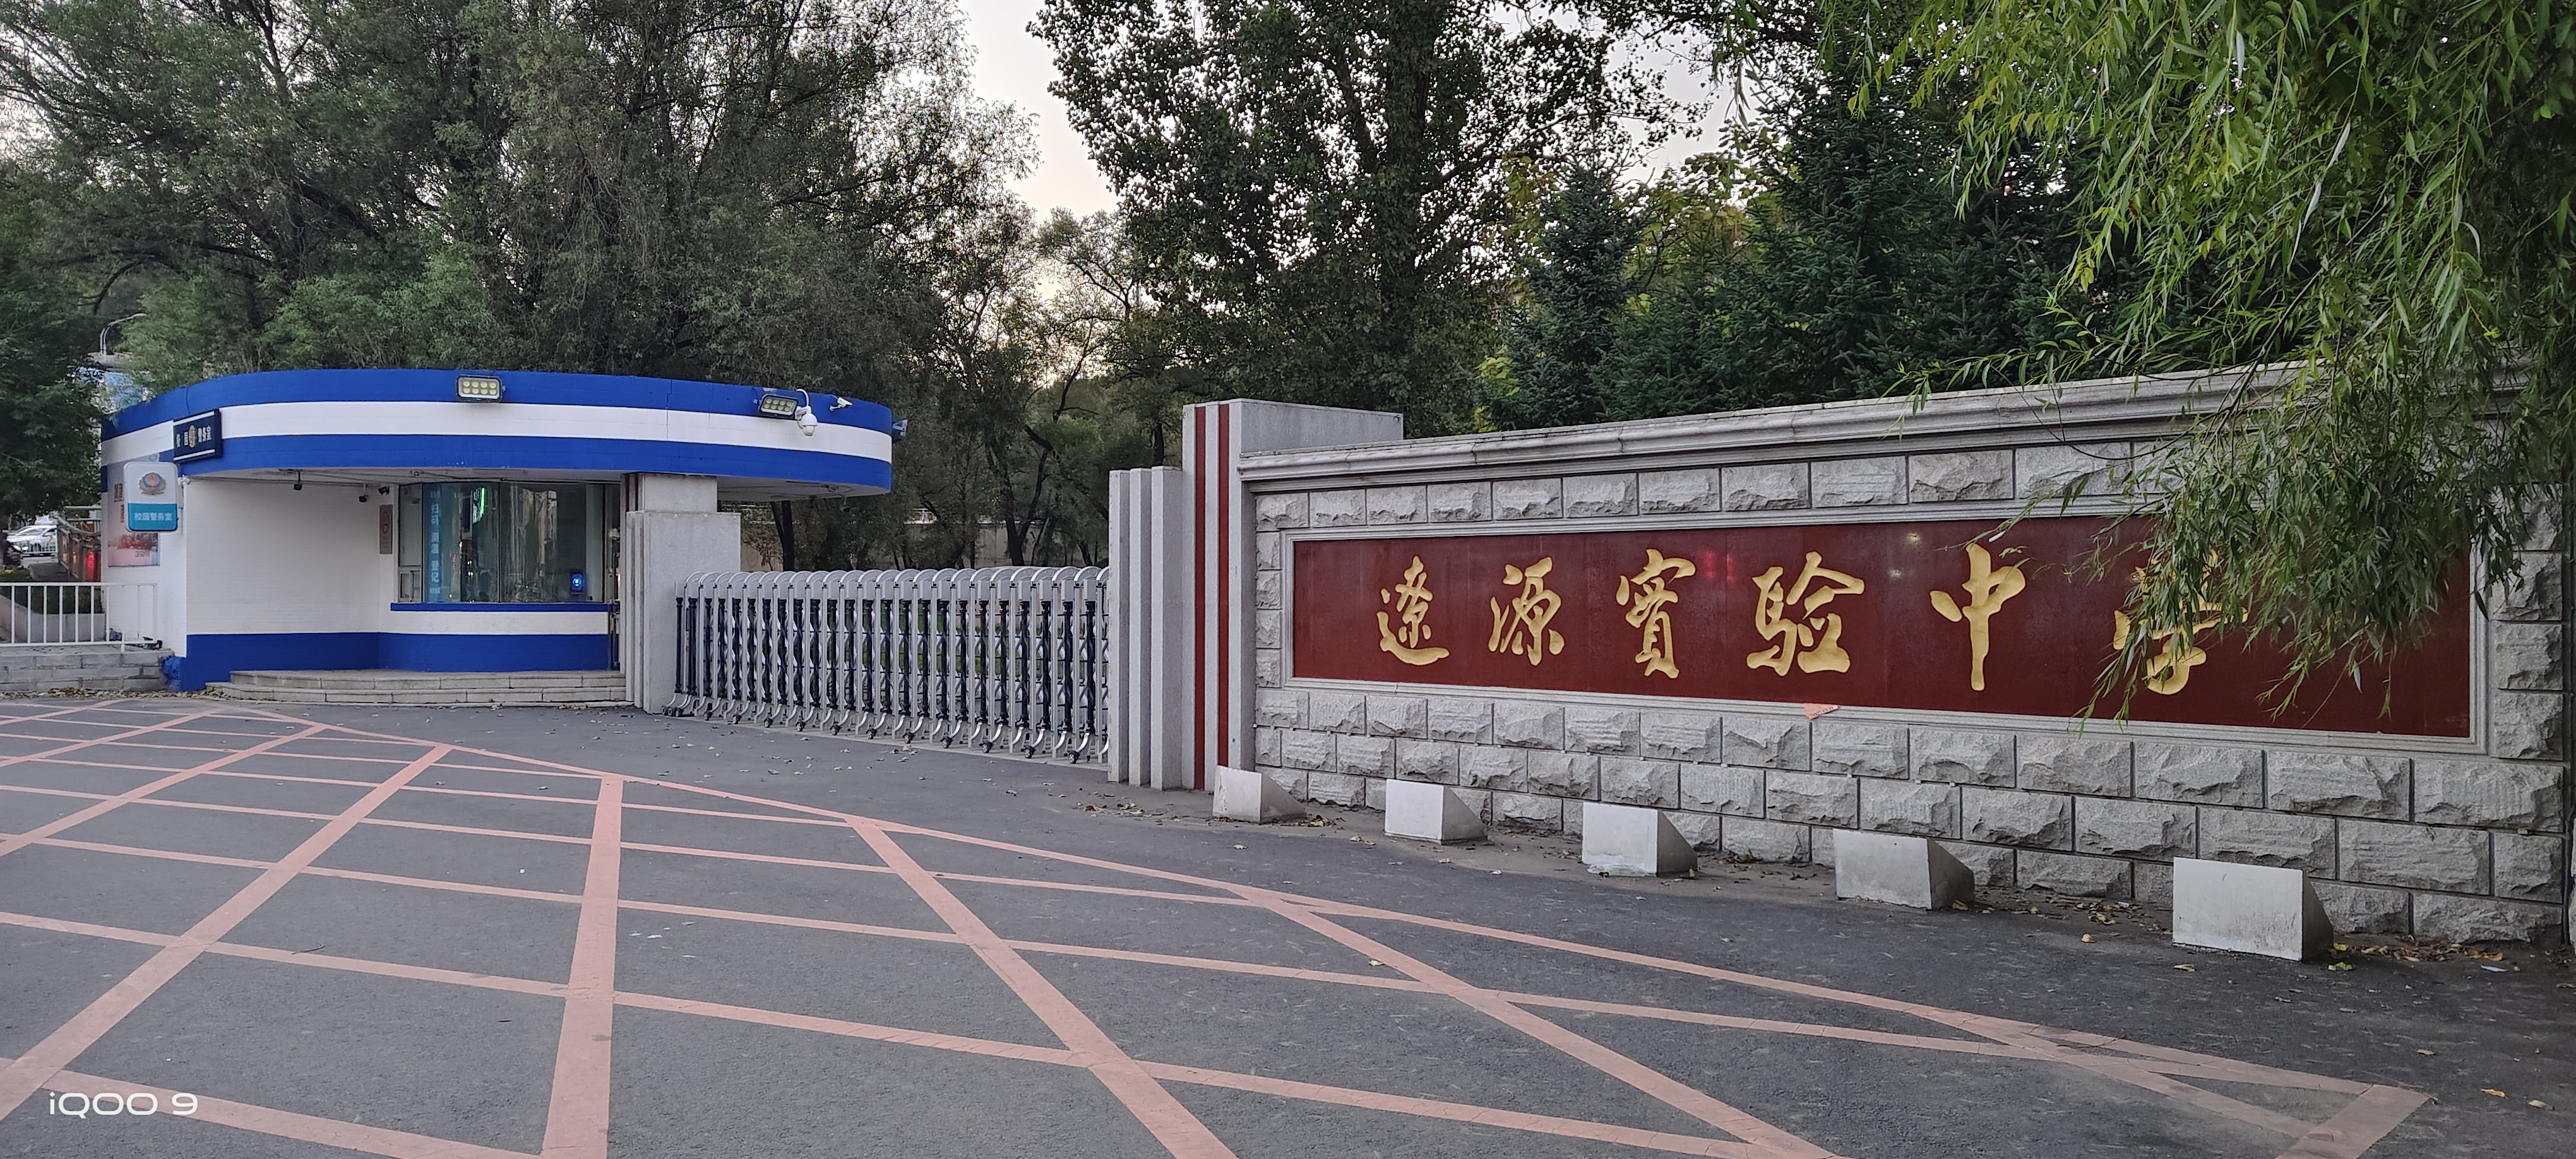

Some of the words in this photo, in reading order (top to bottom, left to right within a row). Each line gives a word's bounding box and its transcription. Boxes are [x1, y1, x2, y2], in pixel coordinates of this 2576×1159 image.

[134, 512, 172, 521] 校园警务室
